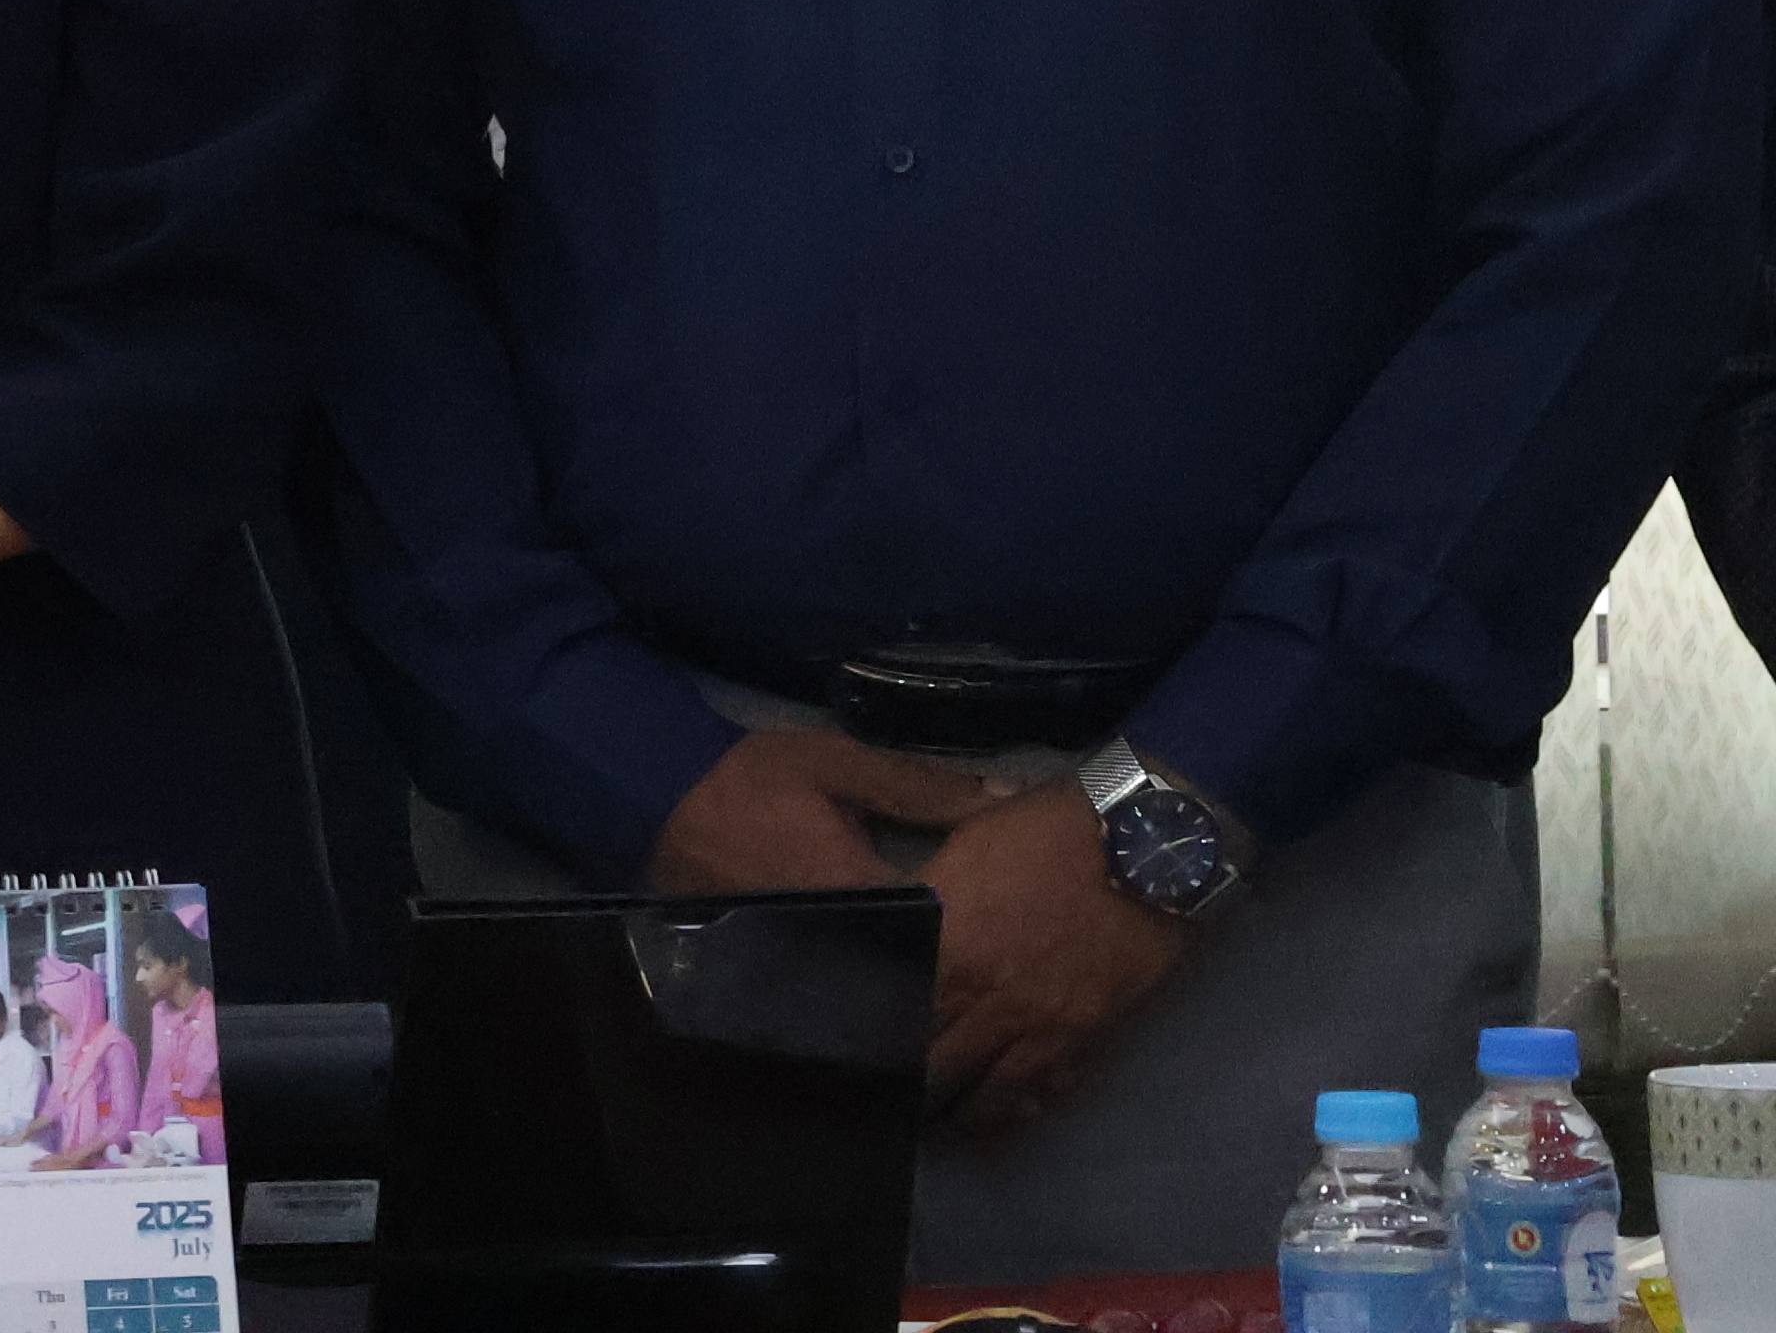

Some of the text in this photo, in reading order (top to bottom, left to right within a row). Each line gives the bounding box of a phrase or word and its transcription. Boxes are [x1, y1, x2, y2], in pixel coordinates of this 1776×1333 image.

[135, 1200, 214, 1231] 2025
[171, 1237, 213, 1260] July
[37, 1290, 65, 1304] Thu
[107, 1287, 129, 1302] Fri
[173, 1285, 196, 1300] Sat
[115, 1317, 125, 1330] 4
[182, 1314, 193, 1329] 5
